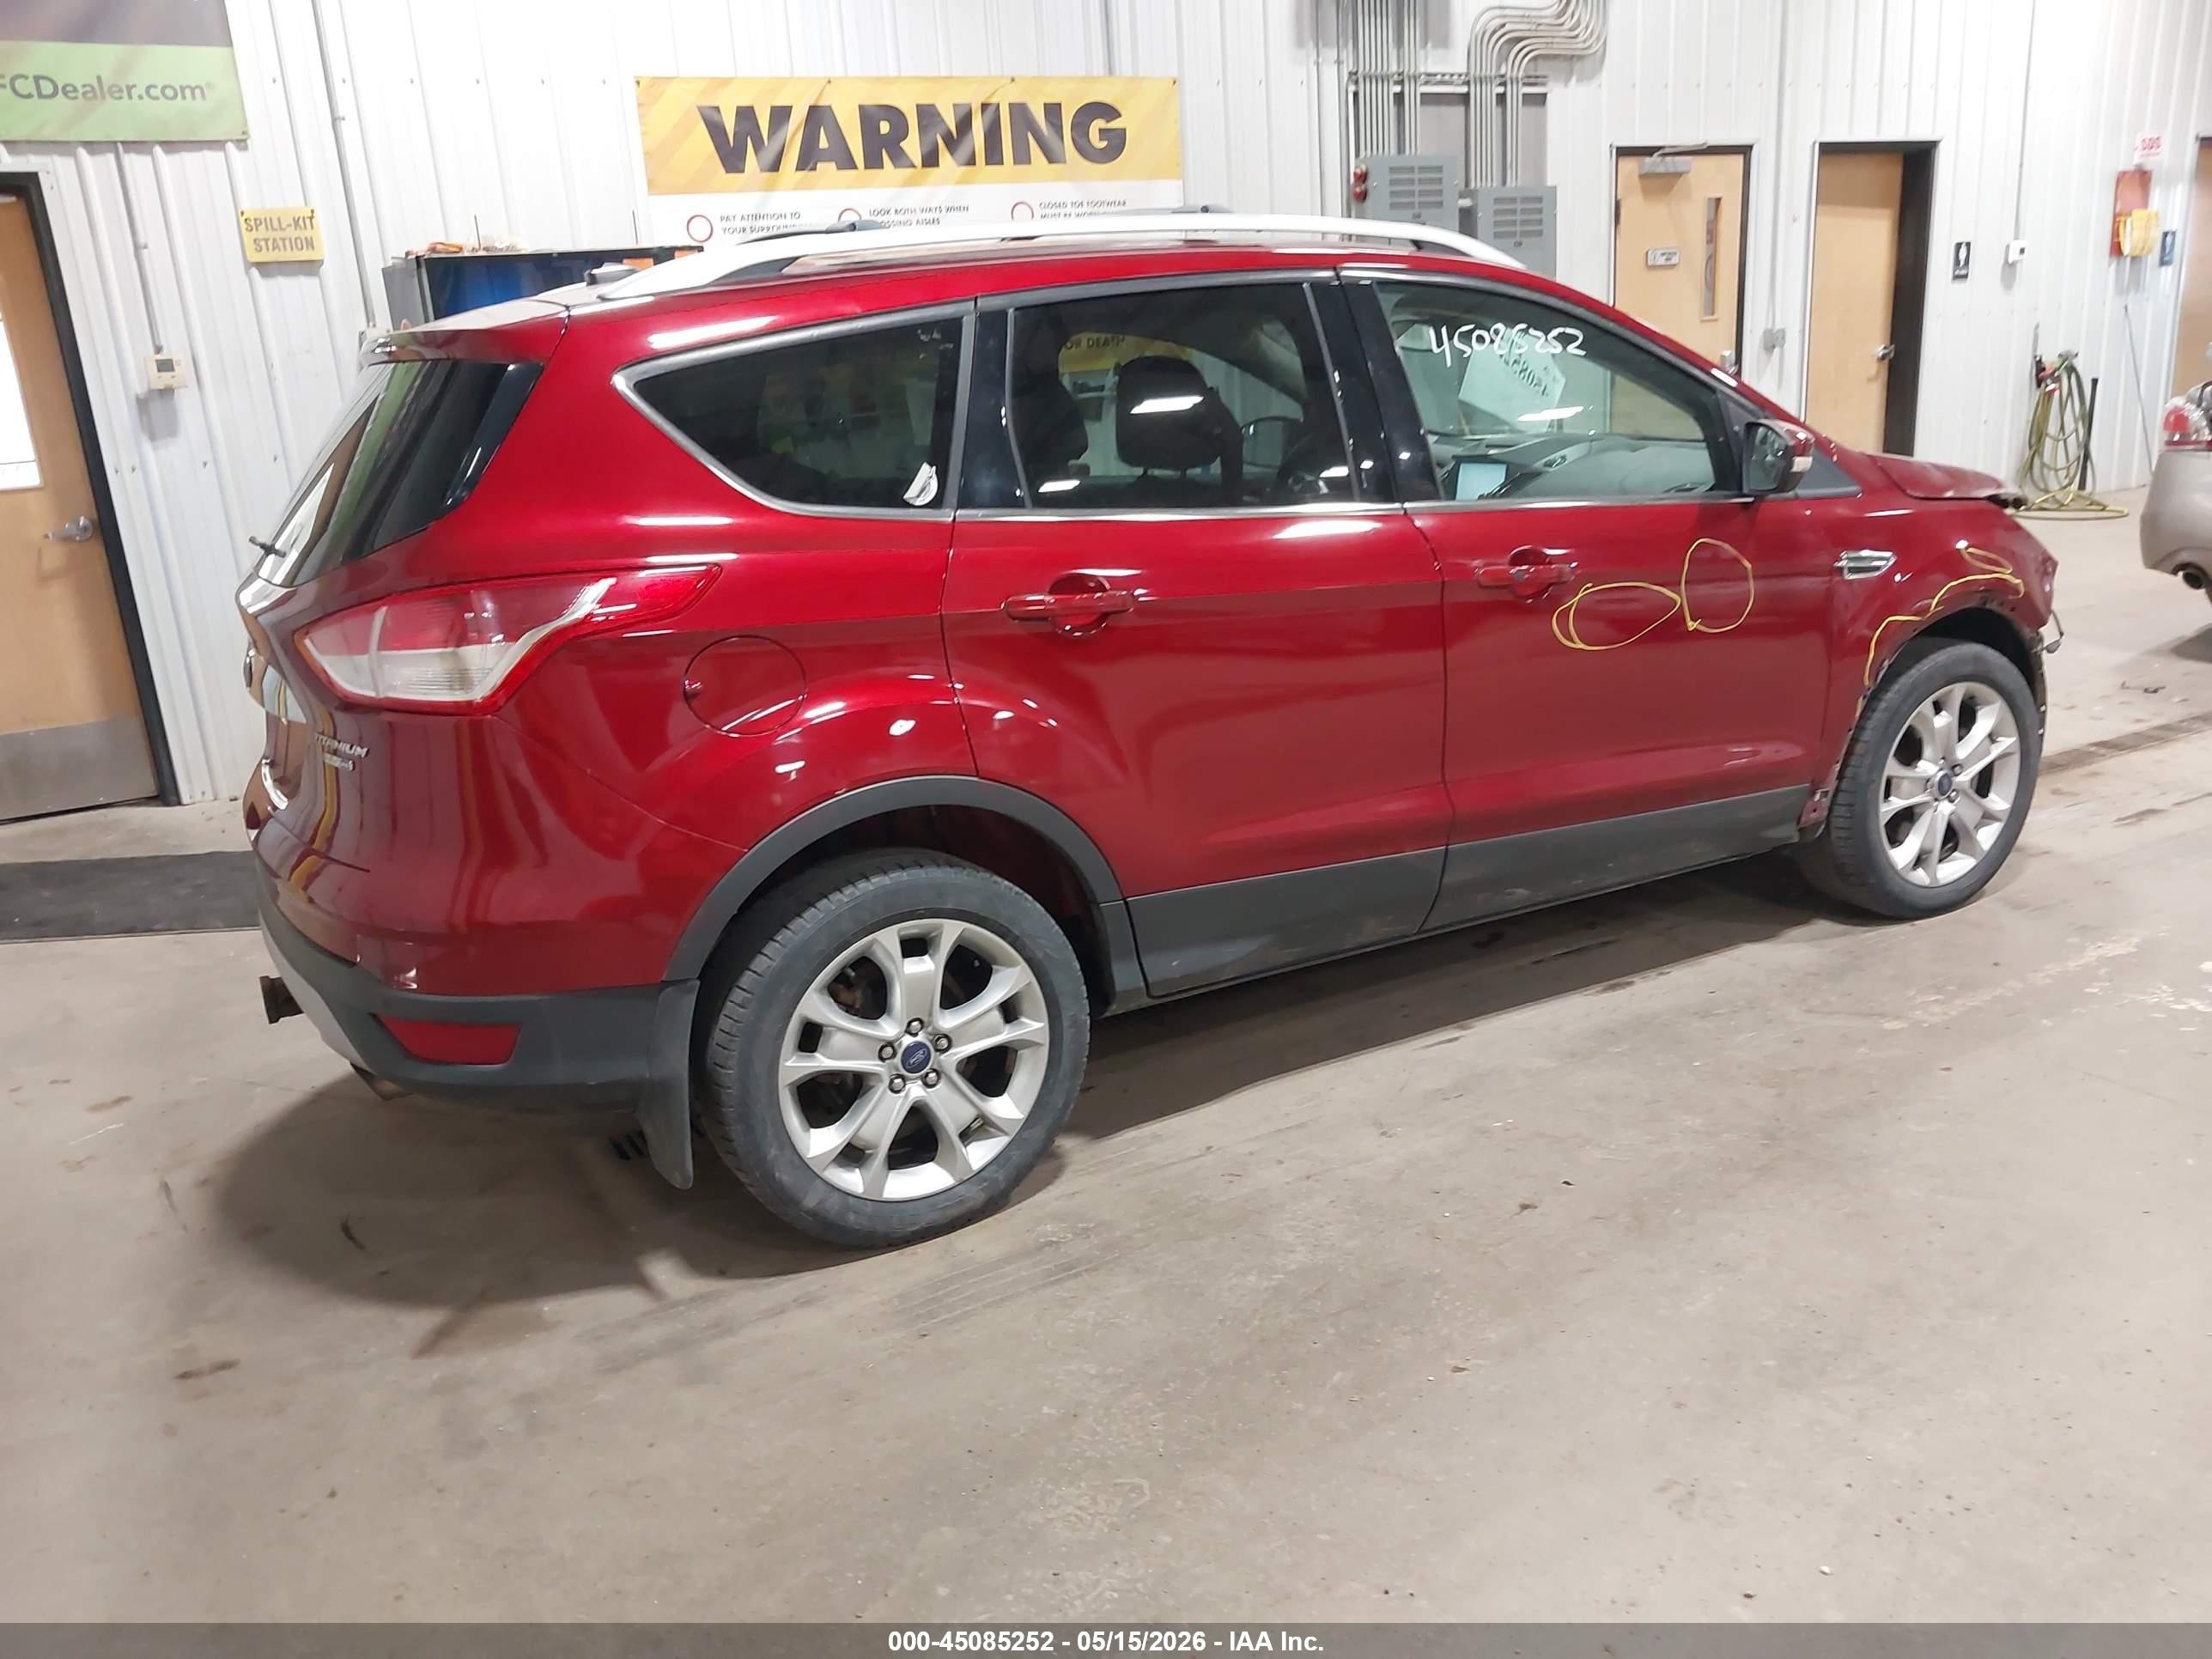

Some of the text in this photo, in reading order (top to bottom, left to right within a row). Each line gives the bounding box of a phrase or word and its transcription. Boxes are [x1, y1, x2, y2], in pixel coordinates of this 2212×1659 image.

[696, 100, 1127, 173] WARNING
[720, 211, 801, 223] PAY ATTENTION TO
[869, 204, 969, 217] LOOK BOTH WAYS WHEN
[244, 216, 315, 233] SPILL-KIT
[722, 225, 746, 235] YOUR
[879, 218, 913, 228] OSSING
[253, 236, 315, 252] STATION
[1429, 322, 1587, 368] 45085252
